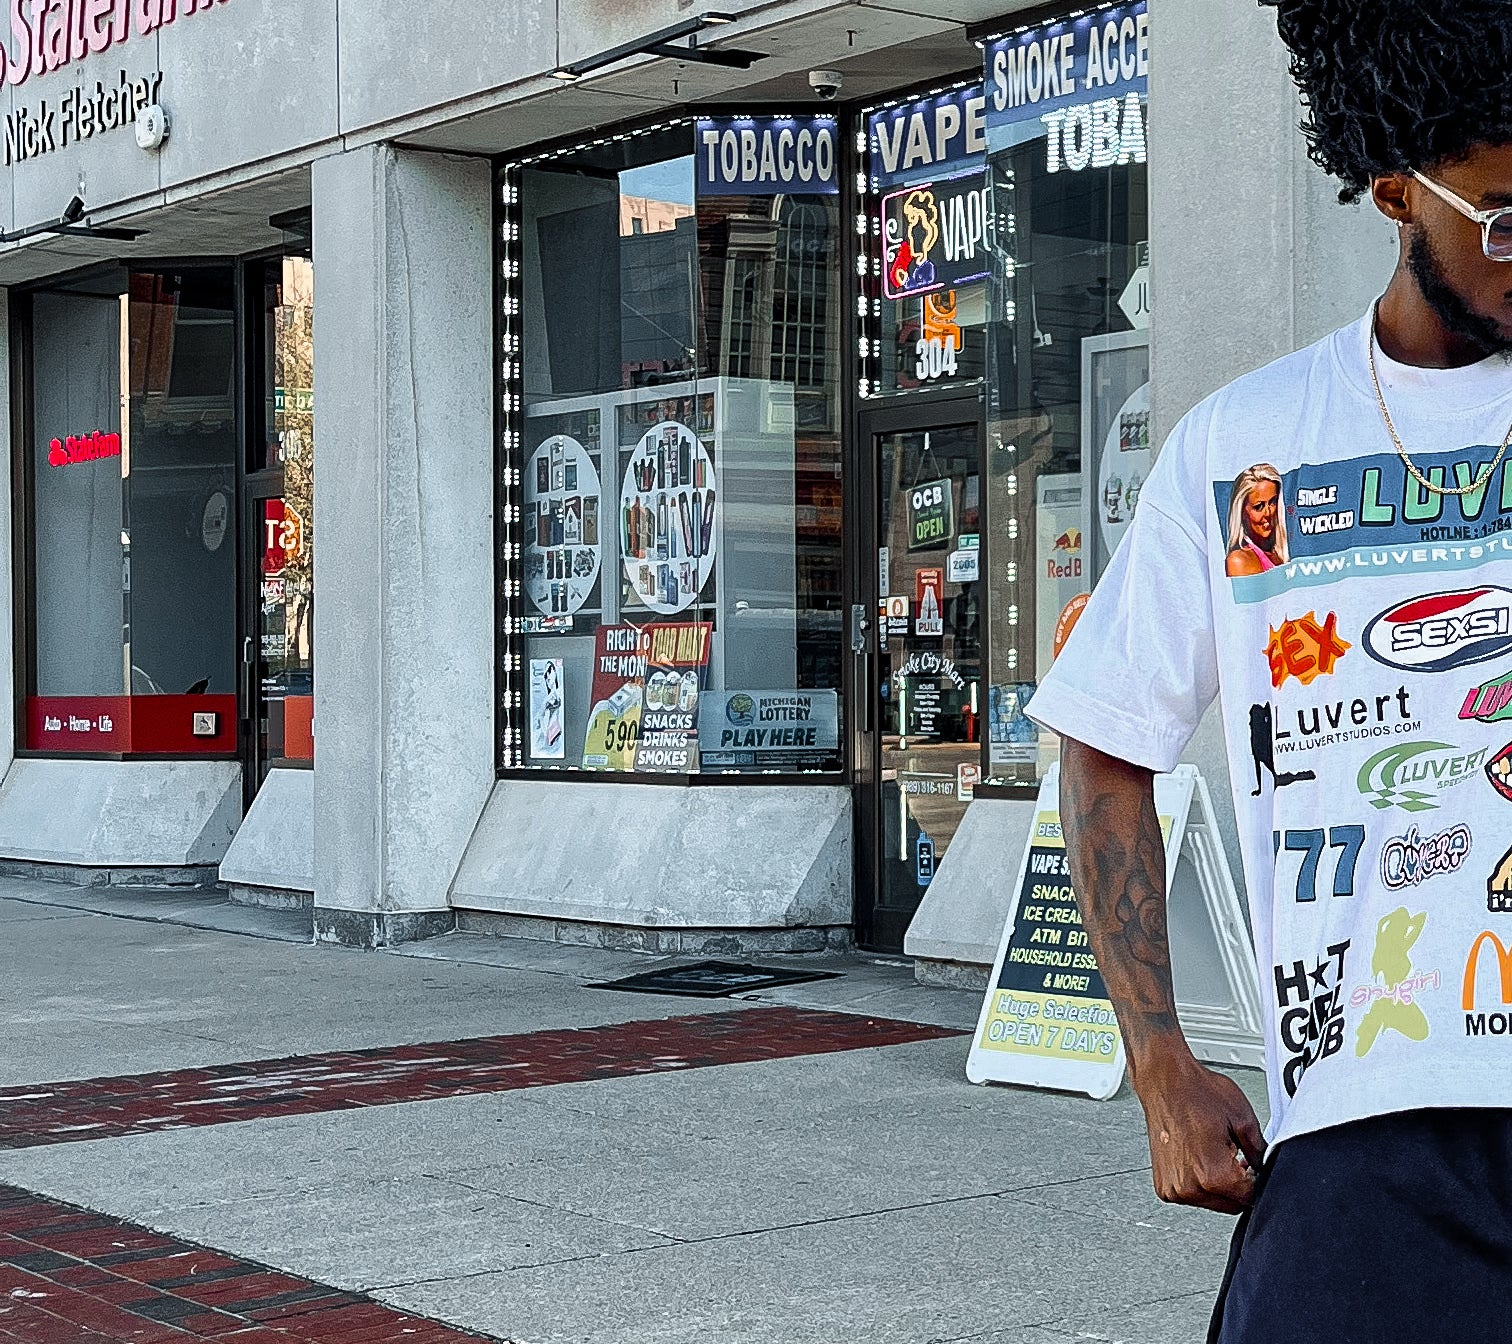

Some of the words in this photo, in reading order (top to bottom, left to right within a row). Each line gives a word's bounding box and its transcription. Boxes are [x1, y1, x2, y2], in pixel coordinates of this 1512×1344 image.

[992, 32, 1076, 114] SMOKE
[4, 100, 56, 167] Nick
[60, 69, 164, 147] Fletcher
[875, 96, 987, 174] VAPE
[702, 128, 834, 184] TOBACCO
[940, 187, 993, 262] VAPE
[915, 336, 958, 380] 304
[912, 486, 943, 510] OCB
[1298, 485, 1338, 507] SINGLE
[916, 516, 944, 540] OPEN
[1047, 557, 1072, 578] Red
[918, 621, 941, 634] PULL
[1391, 606, 1510, 653] SEXSI
[1267, 610, 1347, 689] SEX
[600, 655, 618, 673] THE
[759, 697, 812, 708] MICHIGAN
[1275, 685, 1412, 741] Luvert
[643, 713, 693, 730] SNACKS
[759, 707, 811, 722] LOTTERY
[642, 731, 688, 748] DRINKS
[720, 728, 768, 748] PLAY
[769, 727, 817, 747] HERE
[637, 750, 688, 766] SMOKES
[1400, 744, 1490, 785] LUVERT
[1031, 853, 1061, 875] VAPE
[1022, 905, 1045, 922] ICE
[1045, 906, 1083, 925] CREA
[1029, 927, 1061, 946] ATM
[1008, 947, 1072, 968] HOUSEHOLD
[1043, 972, 1051, 988] &
[1052, 973, 1090, 992] MORE!
[996, 994, 1039, 1020] Huge
[987, 1019, 1043, 1047] OPEN
[1047, 1026, 1060, 1048] 7
[1060, 1028, 1115, 1056] DAYS
